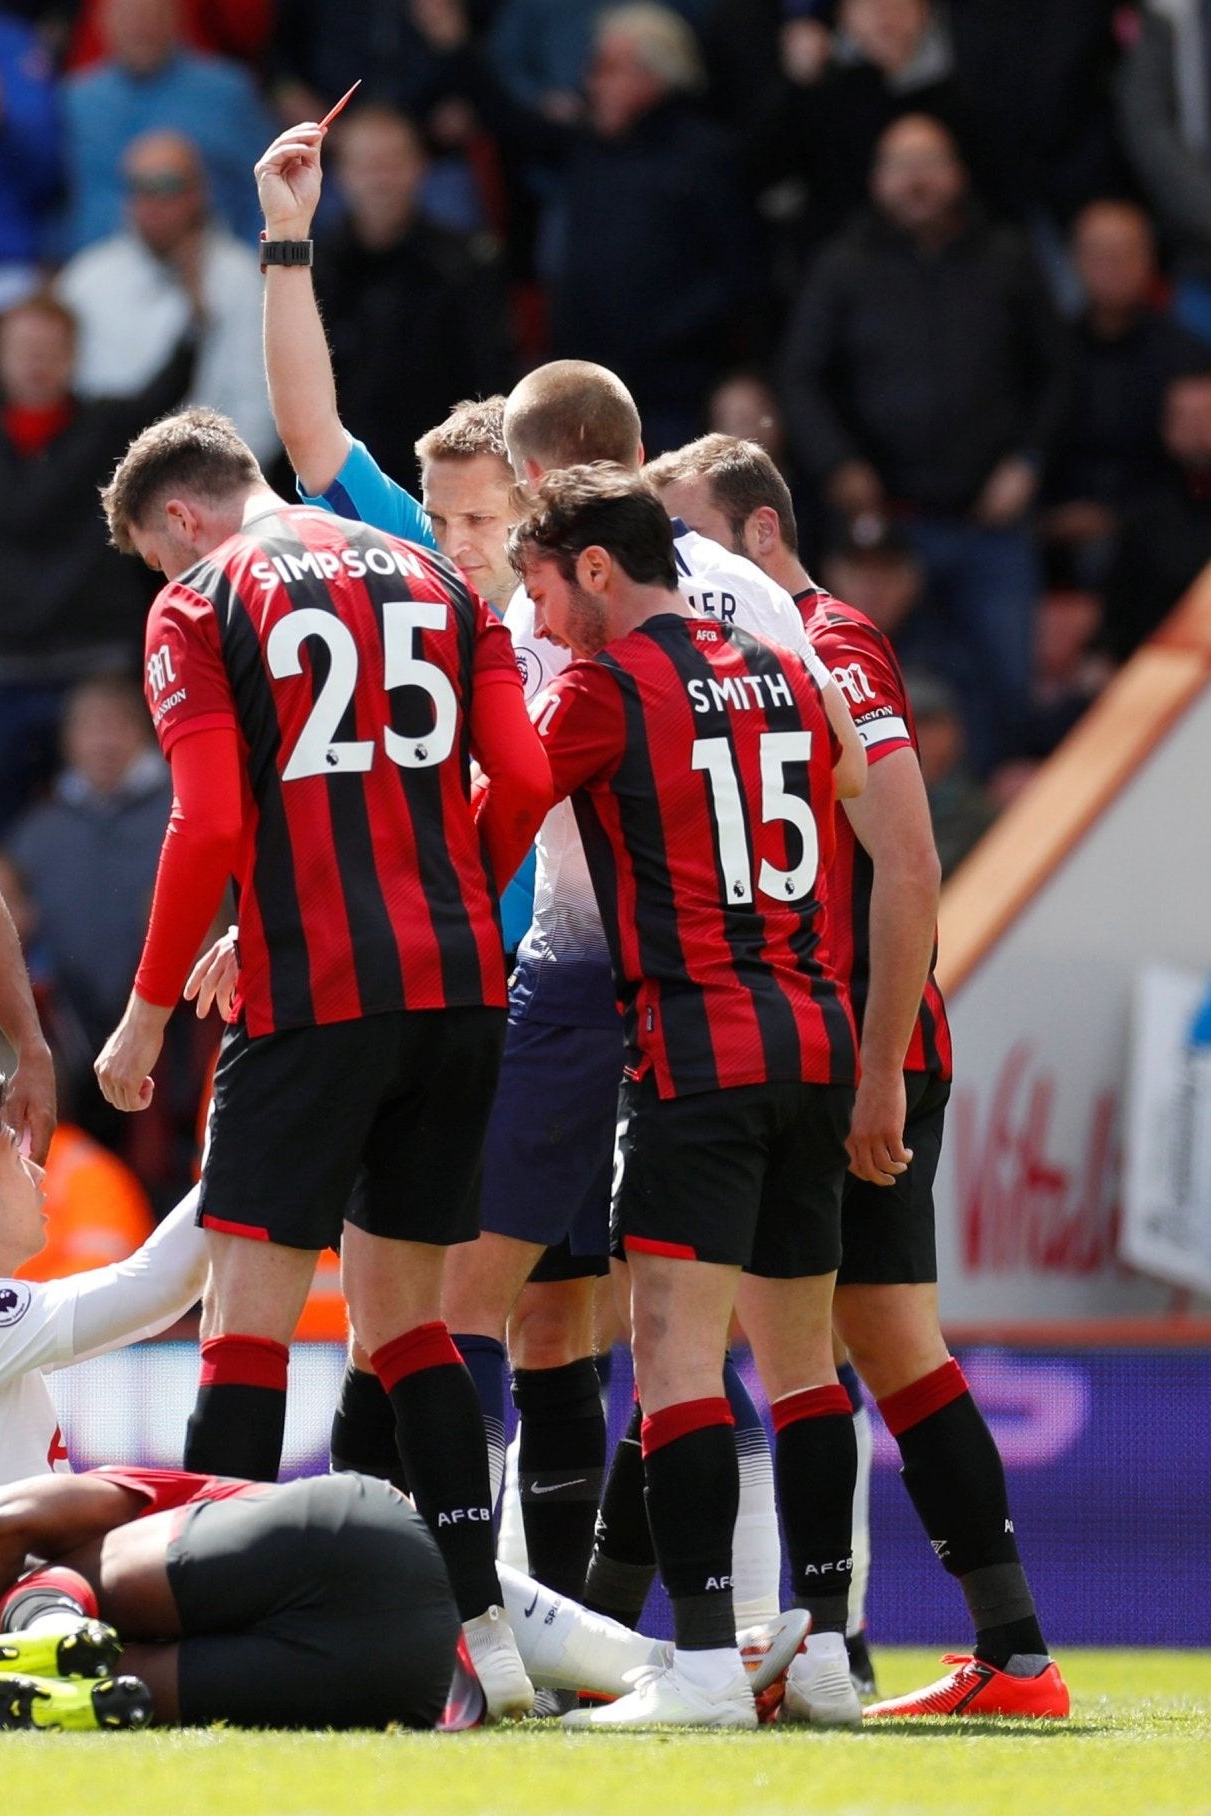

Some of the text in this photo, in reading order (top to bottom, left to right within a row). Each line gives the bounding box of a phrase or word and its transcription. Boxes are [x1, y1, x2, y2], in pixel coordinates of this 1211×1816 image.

[250, 548, 426, 591] SIMPSON
[695, 629, 718, 642] AFCB
[266, 601, 458, 782] 25
[687, 672, 795, 714] SMITH
[691, 730, 820, 905] 15
[438, 1507, 491, 1528] AFCB
